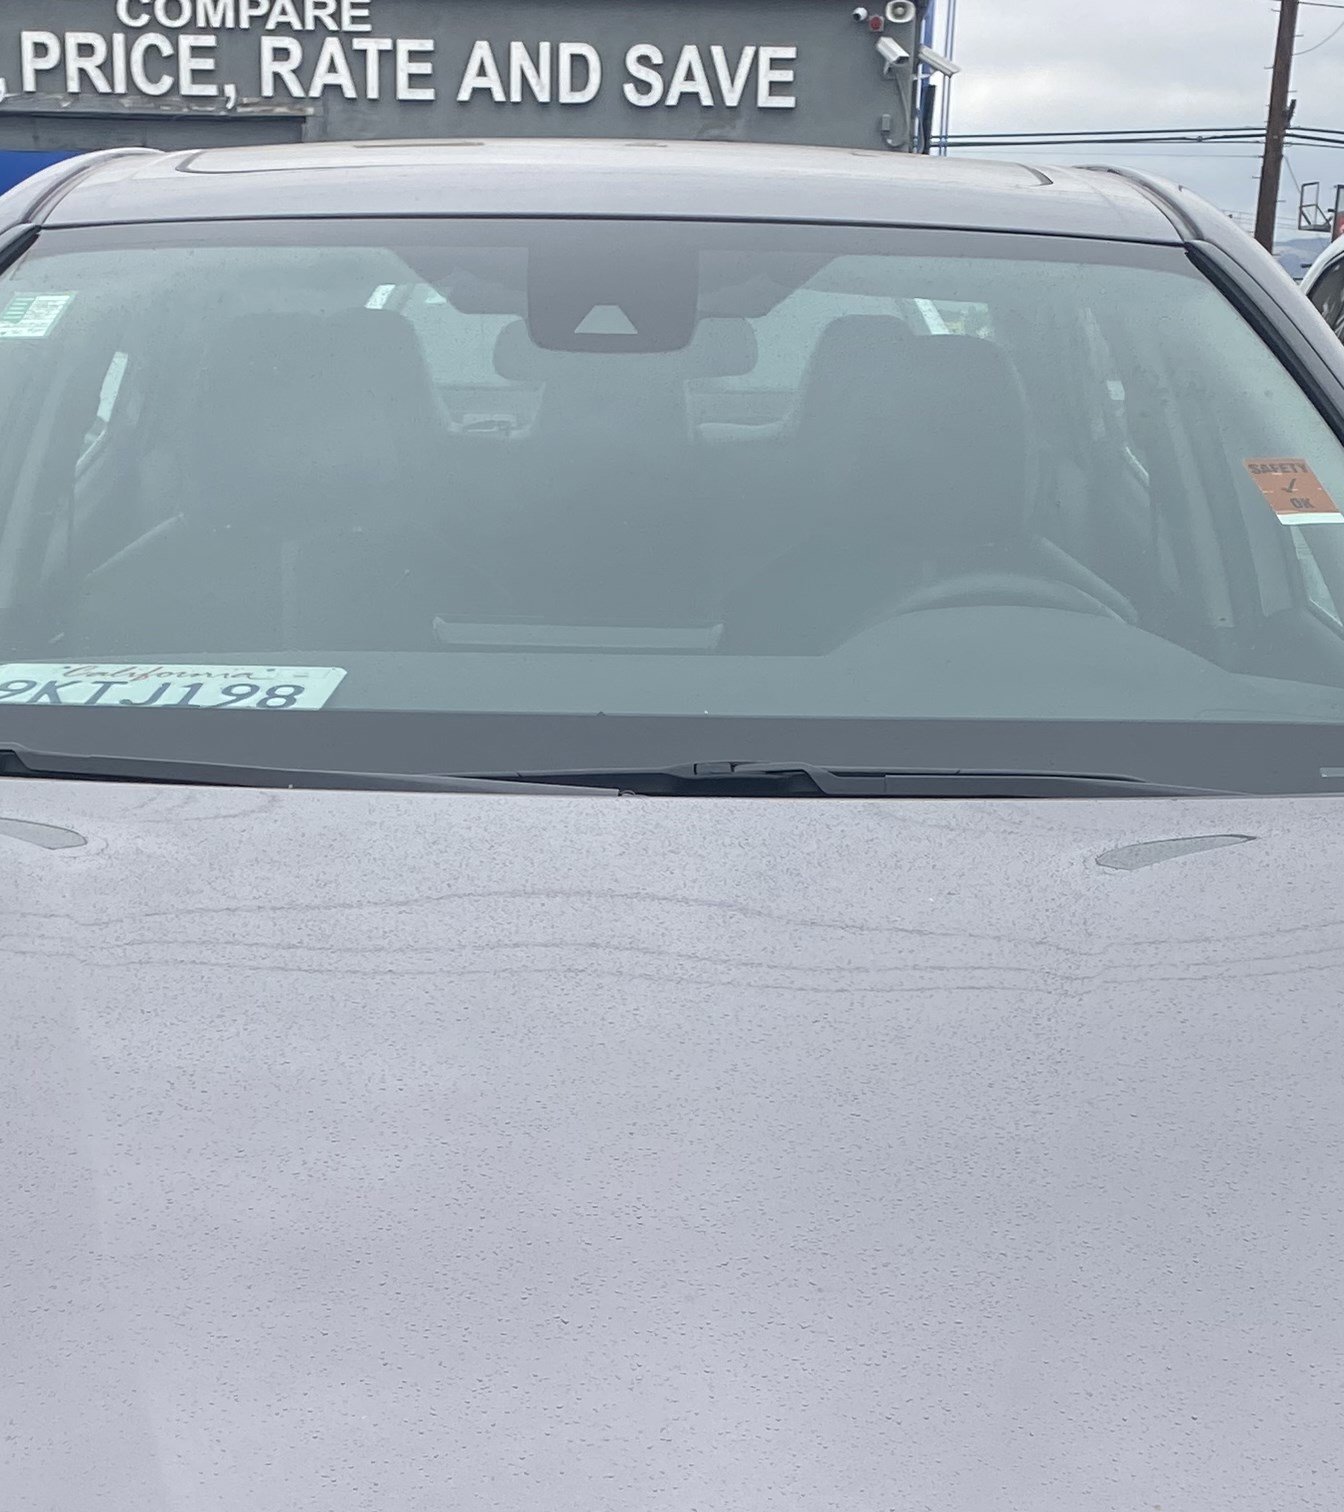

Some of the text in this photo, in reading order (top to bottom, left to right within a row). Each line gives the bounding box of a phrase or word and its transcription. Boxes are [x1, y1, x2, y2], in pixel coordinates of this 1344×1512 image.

[116, 0, 372, 32] COMPARE
[21, 31, 237, 110] PRICE,
[260, 35, 436, 100] RATE
[457, 41, 603, 104] AND
[623, 44, 797, 108] SAVE
[1248, 463, 1308, 475] SAFETY
[1290, 498, 1314, 509] OK
[63, 665, 254, 681] California
